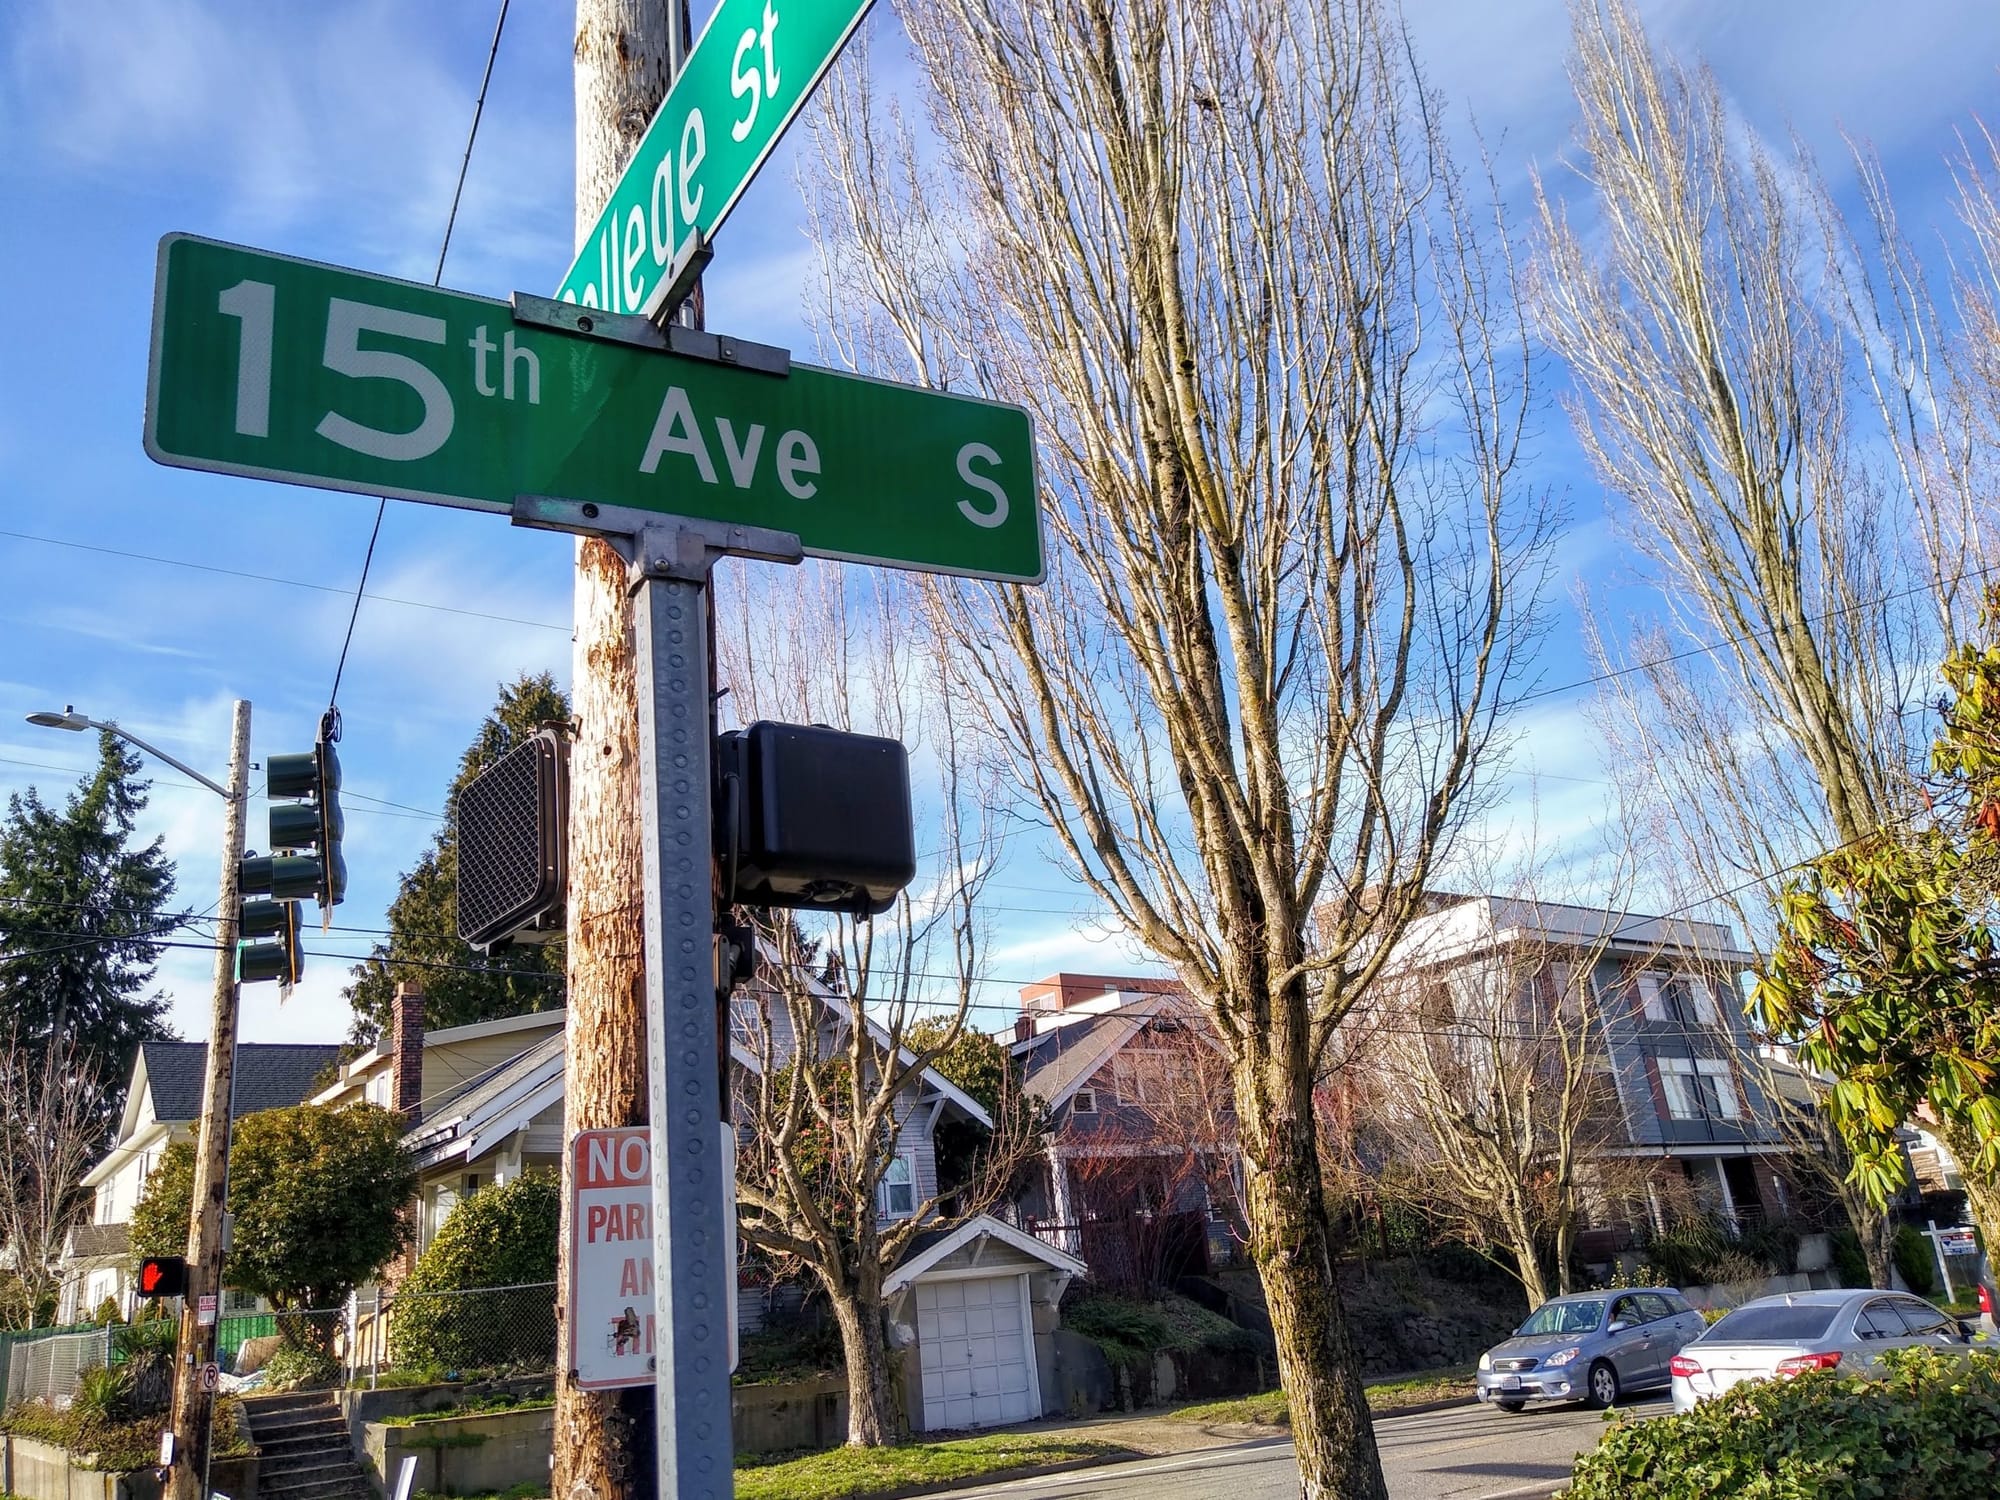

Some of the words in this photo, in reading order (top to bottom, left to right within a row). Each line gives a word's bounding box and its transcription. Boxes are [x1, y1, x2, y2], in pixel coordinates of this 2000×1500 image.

[563, 107, 706, 314] llege
[730, 0, 781, 143] St
[218, 279, 541, 461] 15th
[639, 386, 821, 500] Ave
[955, 442, 1010, 529] S
[588, 1136, 650, 1183] NO
[619, 1257, 656, 1297] AN
